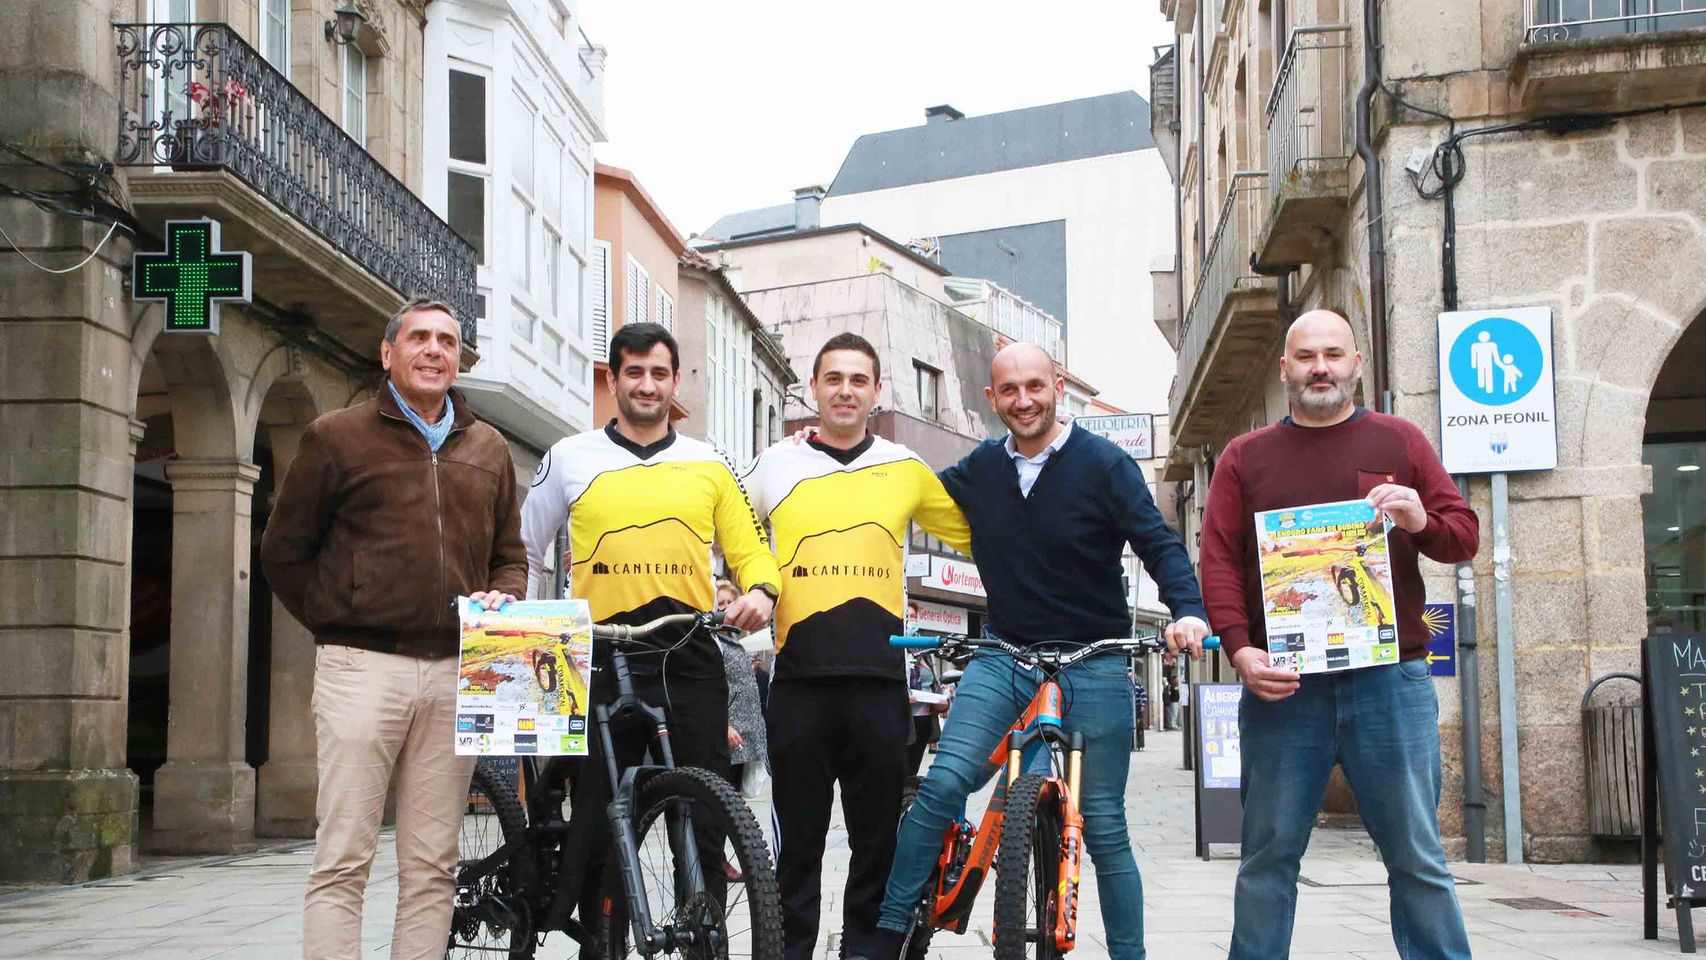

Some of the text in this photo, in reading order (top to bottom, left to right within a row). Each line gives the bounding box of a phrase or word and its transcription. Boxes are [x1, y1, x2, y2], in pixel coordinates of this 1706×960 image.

[1446, 411, 1550, 427] ZONA PEONIL
[613, 563, 694, 576] CANTEIROS
[812, 565, 891, 579] CANTEIROS
[919, 606, 941, 622] General
